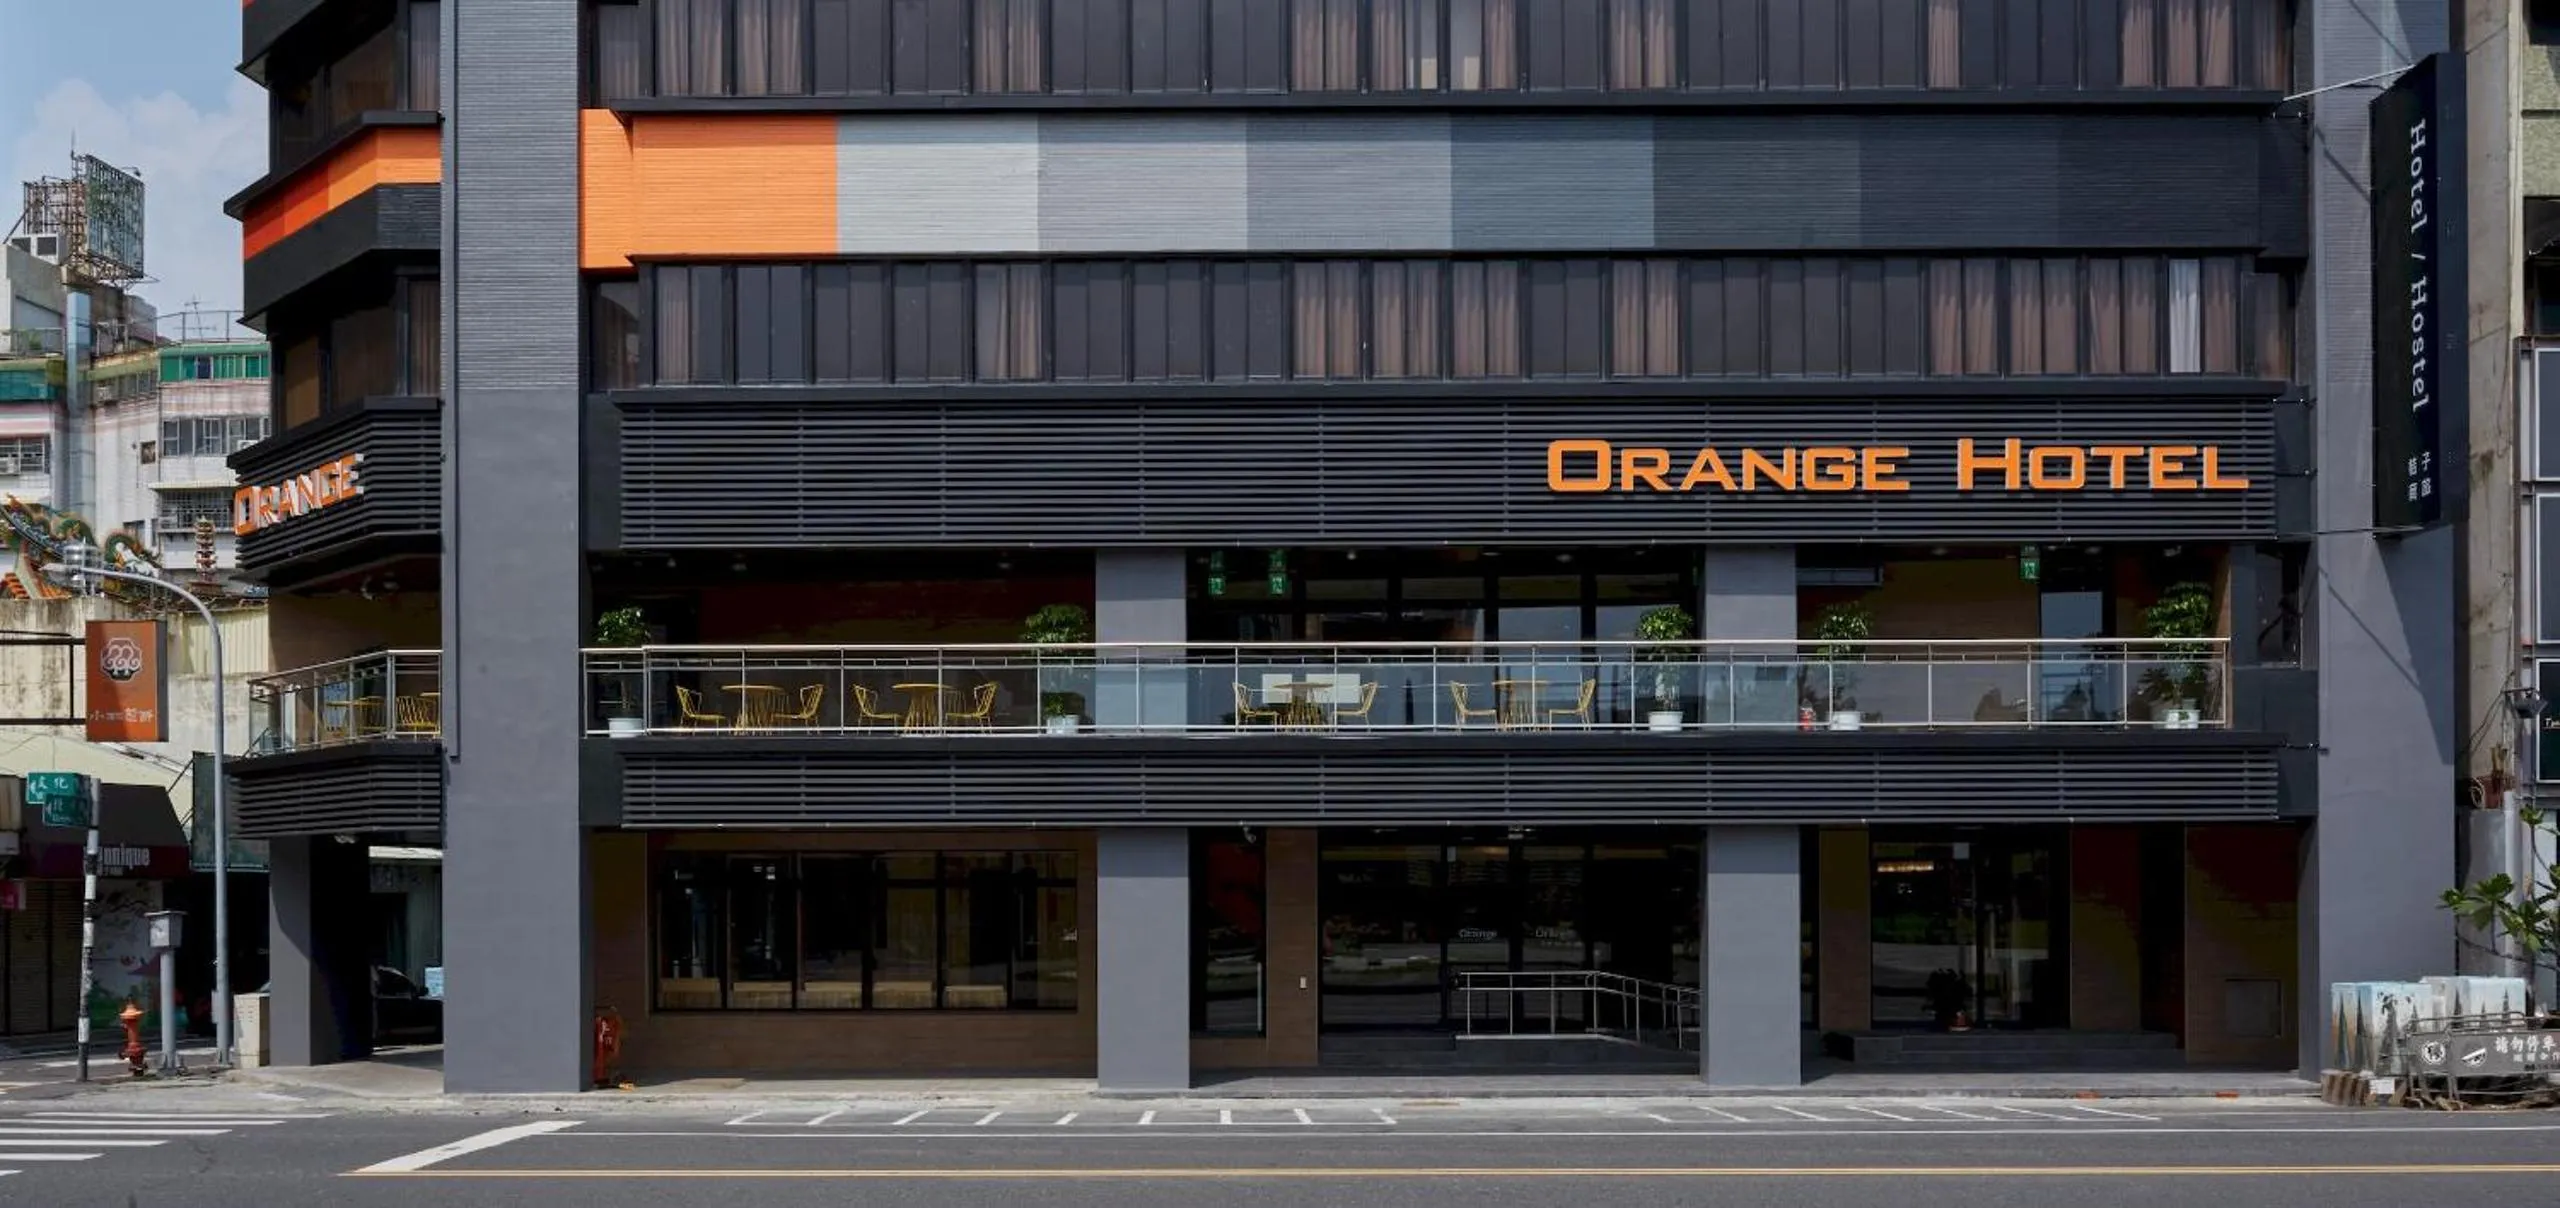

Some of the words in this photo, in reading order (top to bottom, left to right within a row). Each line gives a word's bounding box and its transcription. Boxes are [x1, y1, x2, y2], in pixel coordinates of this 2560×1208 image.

[2411, 118, 2427, 233] Hotel
[2411, 276, 2429, 412] Hostel
[234, 452, 365, 536] ORANGE
[1547, 438, 1910, 492] ORANGE
[1957, 437, 2250, 491] HOTEL
